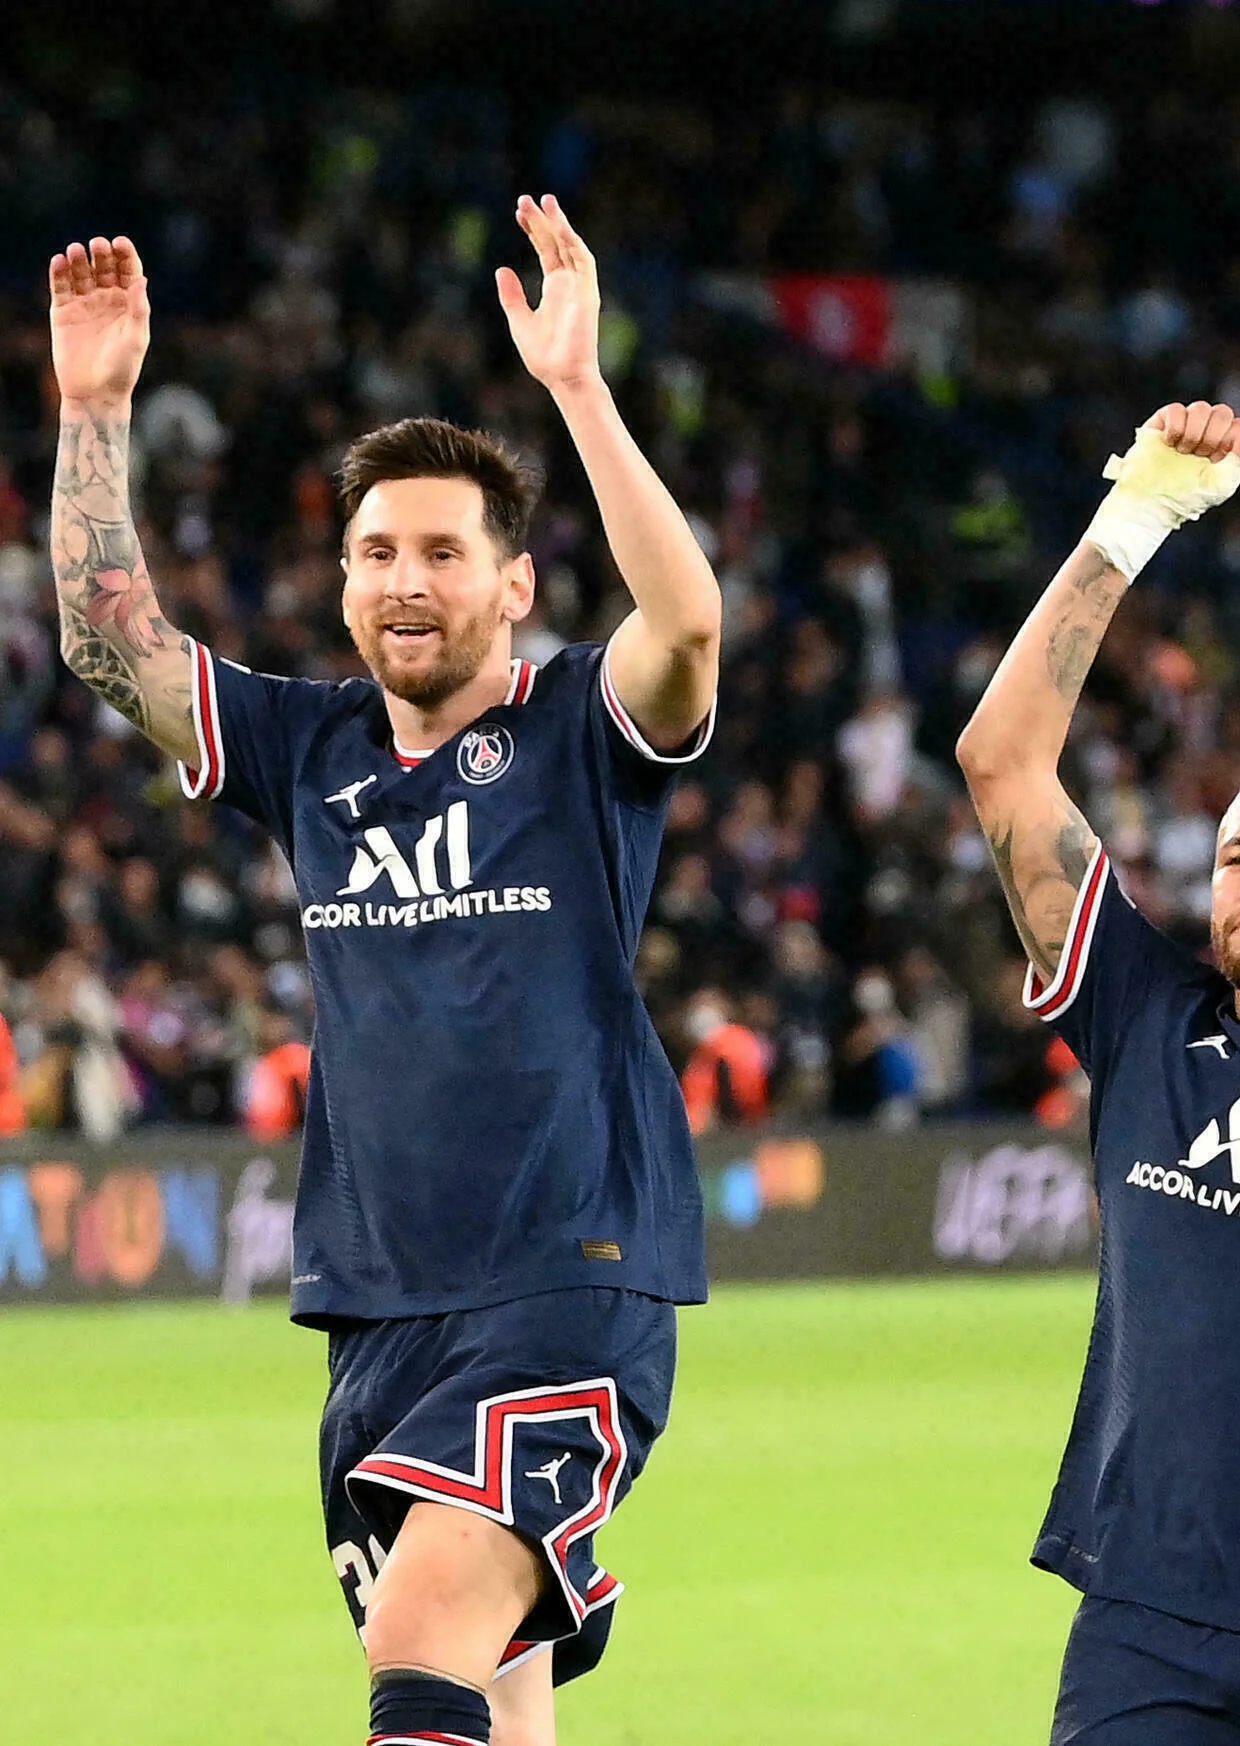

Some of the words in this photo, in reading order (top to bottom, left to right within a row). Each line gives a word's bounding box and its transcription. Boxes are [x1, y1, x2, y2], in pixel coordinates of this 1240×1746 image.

[301, 903, 362, 929] COR
[365, 902, 418, 928] LIVE
[420, 887, 552, 923] LIMITLESS
[1126, 1161, 1196, 1201] ACCOR
[331, 1532, 388, 1648] 3
